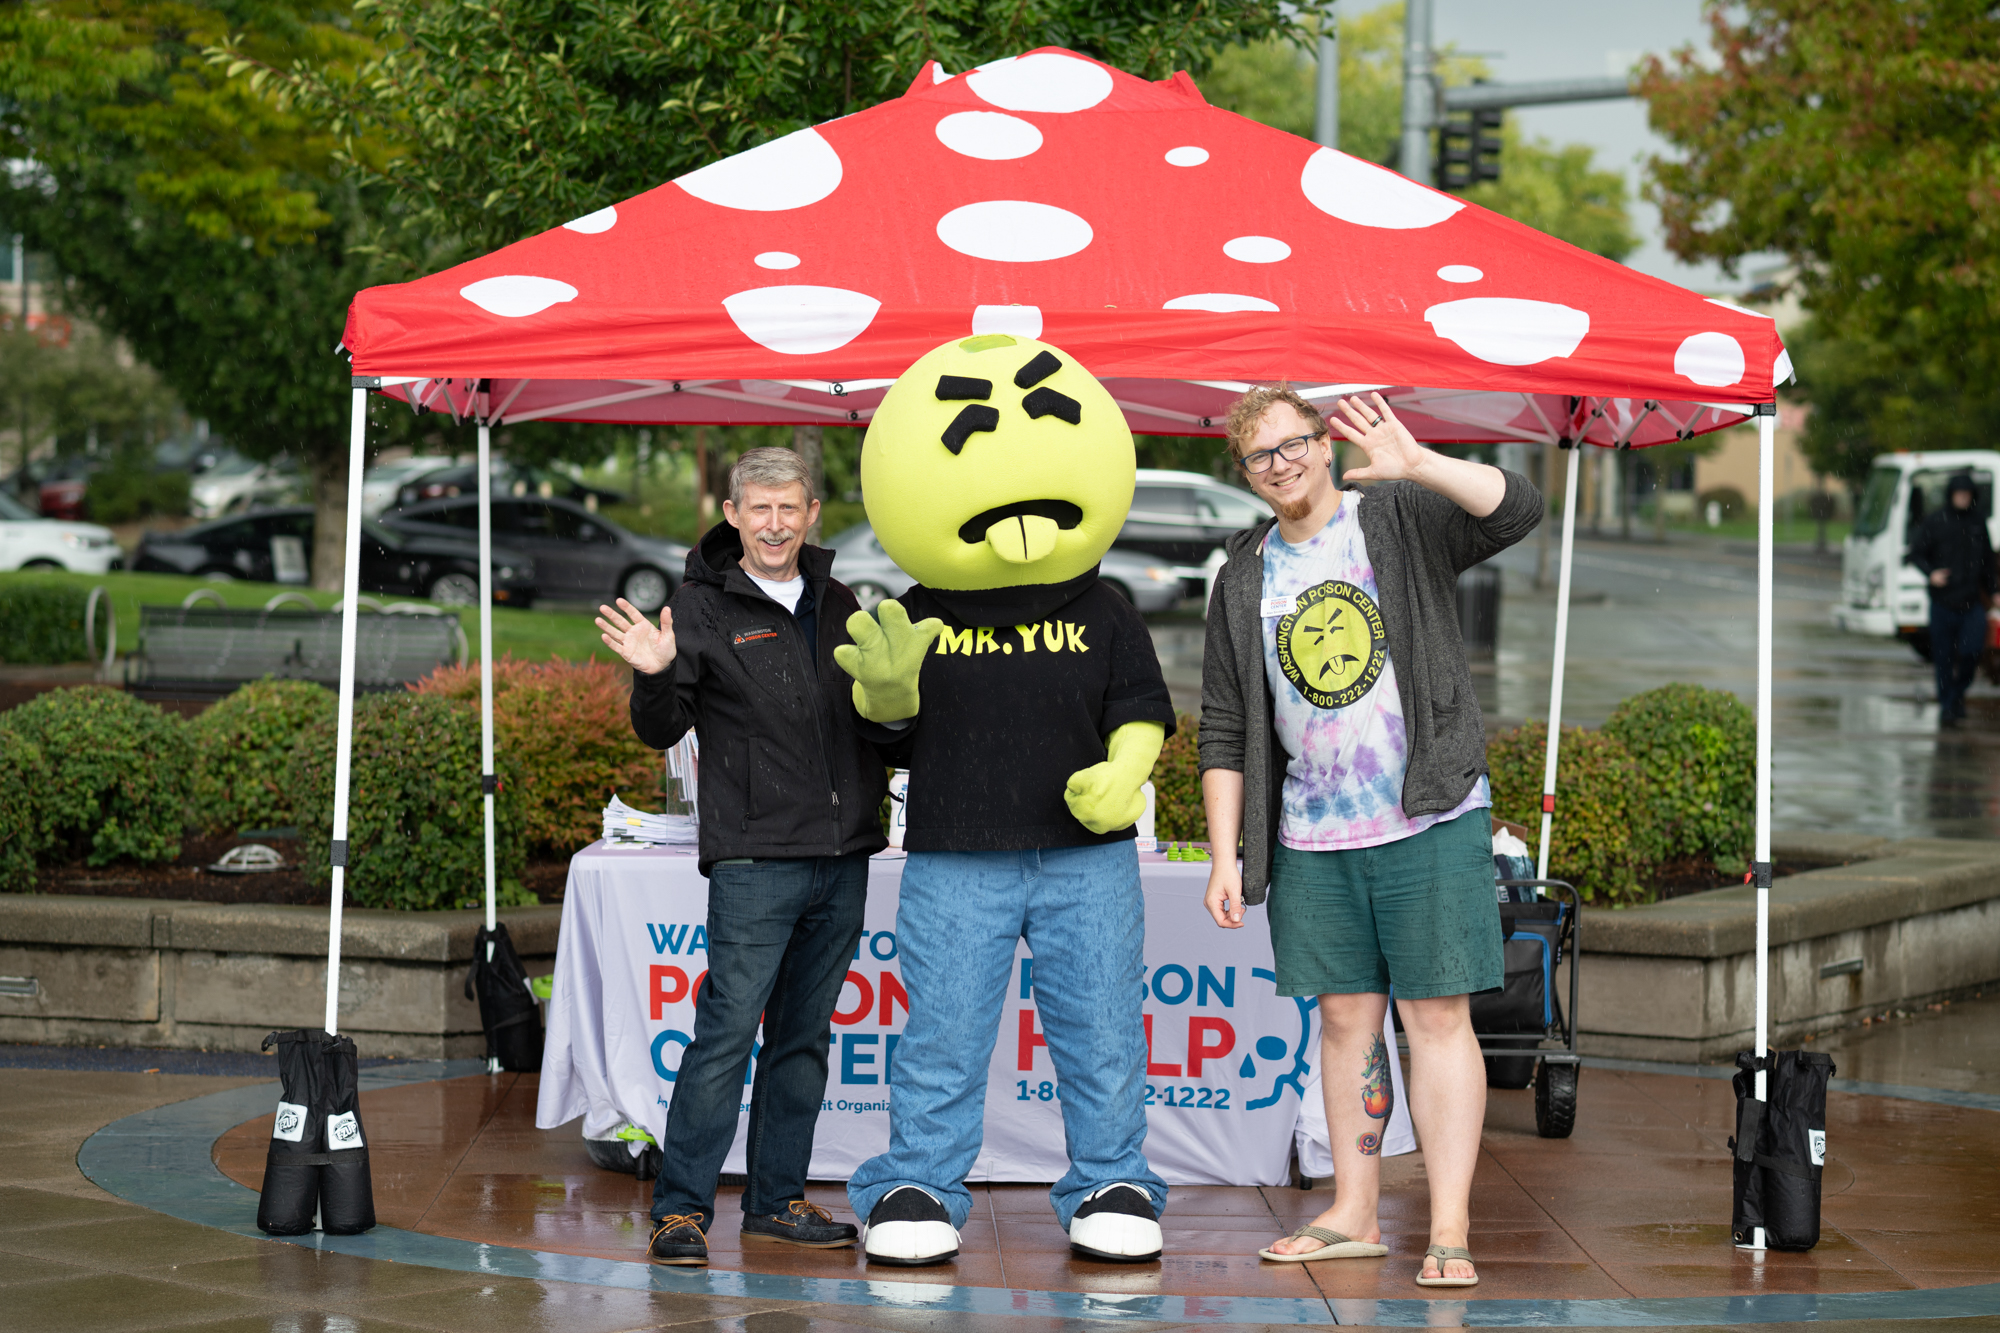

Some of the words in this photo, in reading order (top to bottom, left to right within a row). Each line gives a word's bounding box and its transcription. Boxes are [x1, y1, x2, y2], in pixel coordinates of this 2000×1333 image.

[1308, 583, 1351, 601] POSON
[1352, 592, 1385, 639] CENTER
[1303, 649, 1385, 706] 1-800-222-1222
[1017, 1009, 1236, 1078] HLP
[836, 1099, 890, 1114] Organiz
[1016, 1080, 1231, 1110] 1-82-1222
